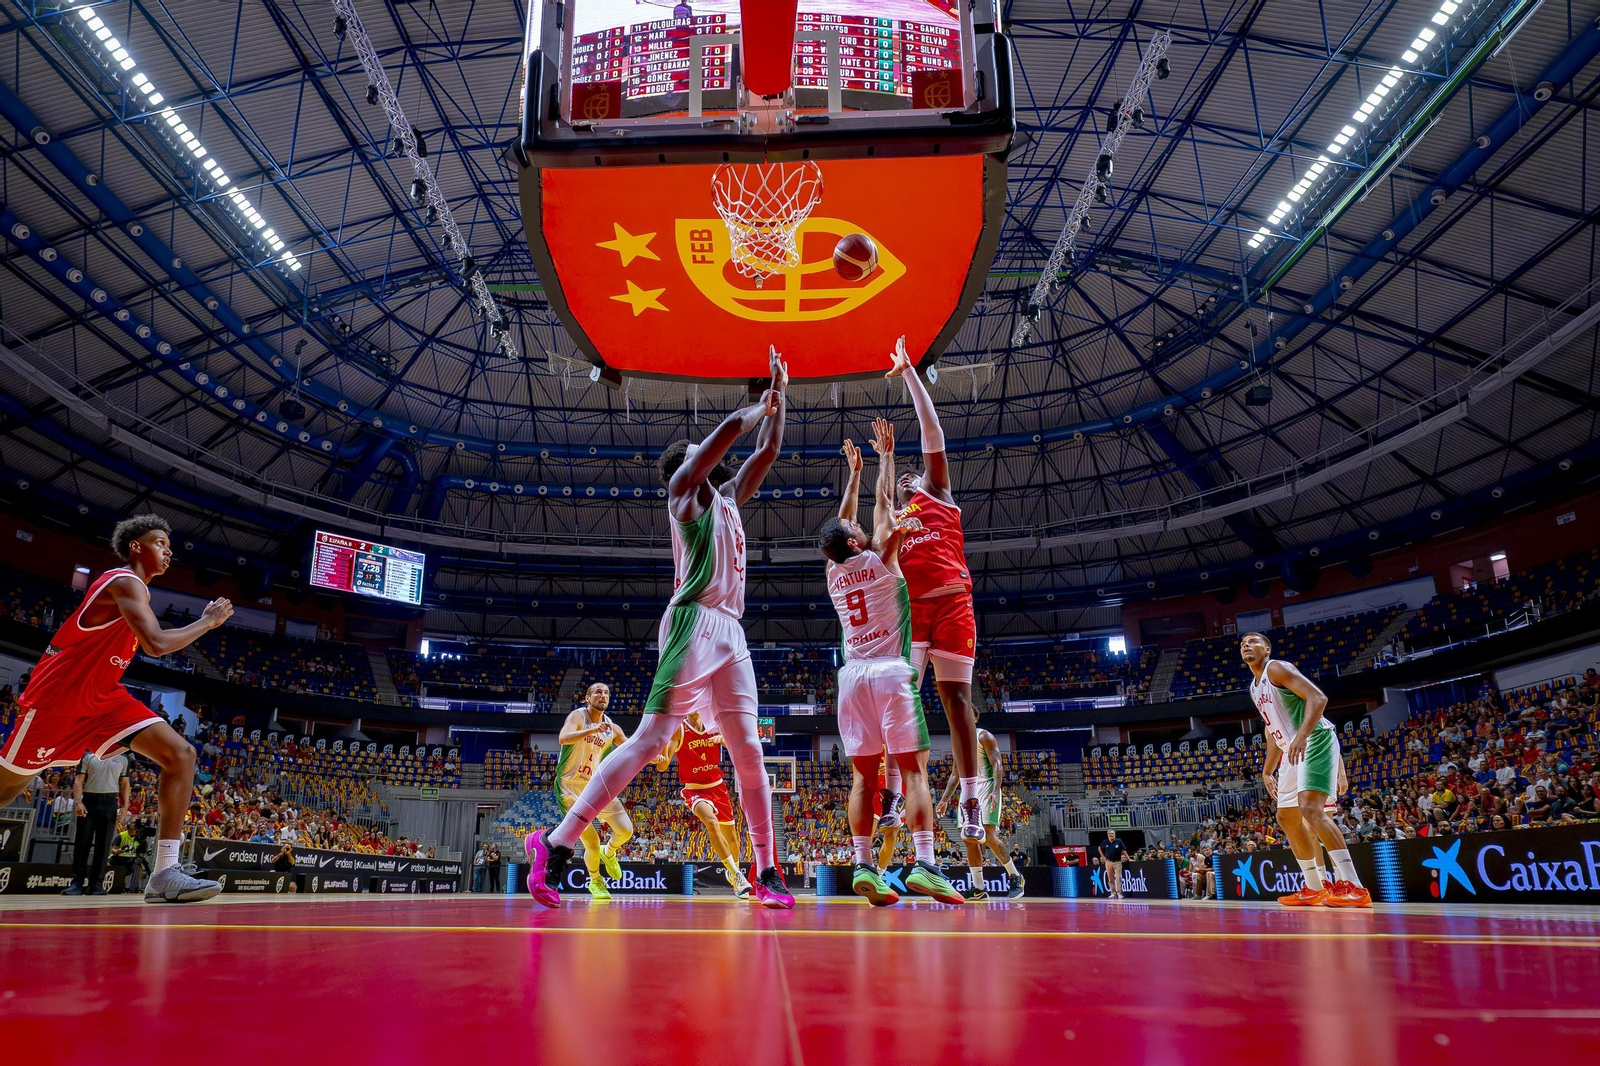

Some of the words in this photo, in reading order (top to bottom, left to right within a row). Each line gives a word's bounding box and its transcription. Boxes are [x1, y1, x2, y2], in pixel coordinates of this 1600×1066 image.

[648, 18, 691, 30] FOLGUEIRAS
[920, 25, 950, 36] GAMEIRO
[649, 41, 673, 50] MILLER
[921, 46, 940, 55] SILVA
[923, 56, 941, 66] NUNO
[690, 229, 714, 264] FEB
[901, 531, 940, 554] ndesa
[362, 563, 380, 573] 7:28
[835, 568, 876, 590] VENTURA
[845, 589, 868, 627] 9
[701, 753, 706, 761] 4
[229, 850, 258, 863] endesa
[335, 858, 353, 868] endesa
[567, 868, 667, 889] CaxaBank
[1103, 869, 1148, 892] CaBank
